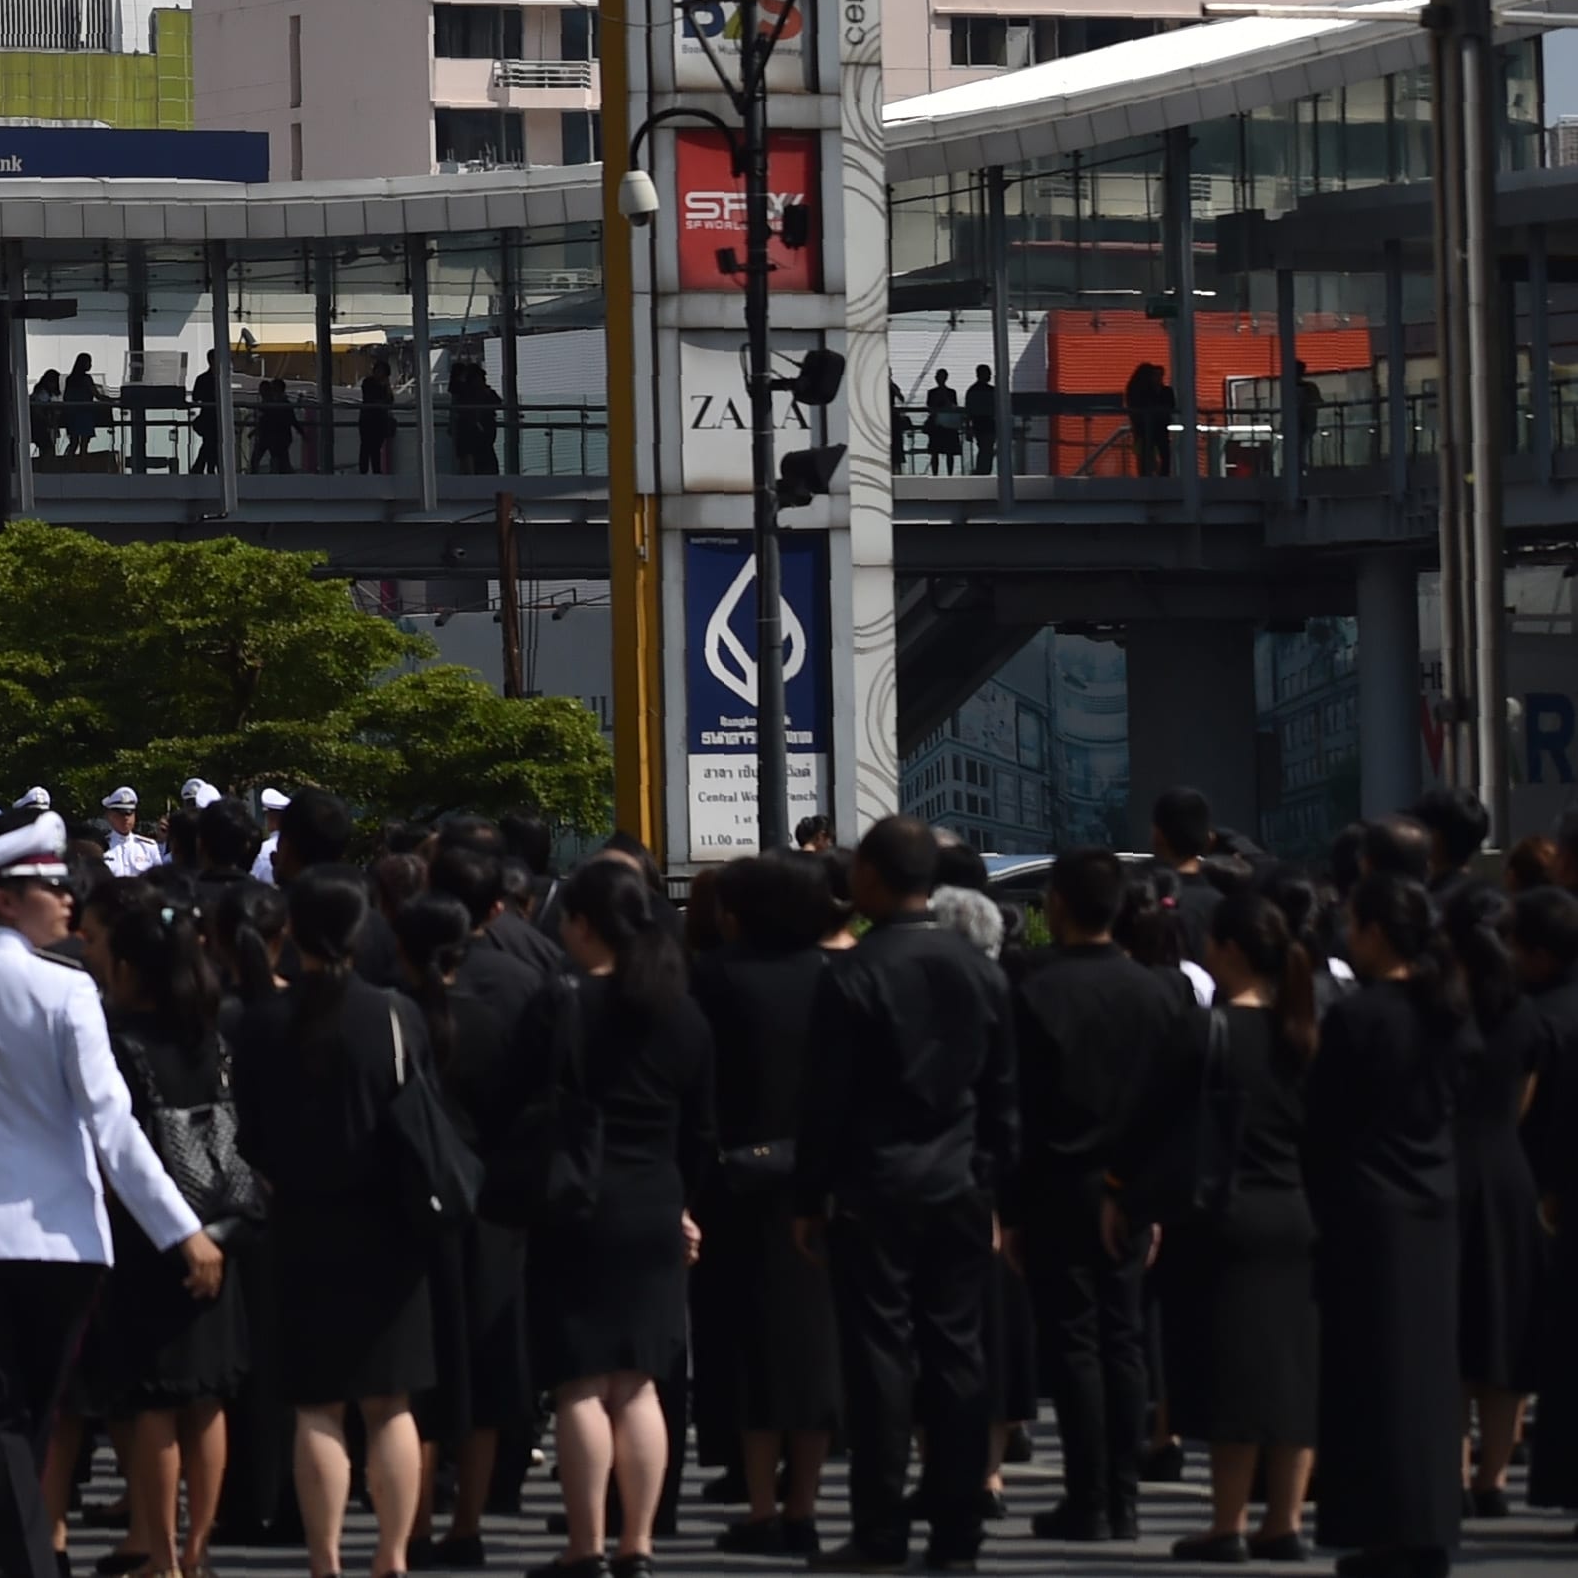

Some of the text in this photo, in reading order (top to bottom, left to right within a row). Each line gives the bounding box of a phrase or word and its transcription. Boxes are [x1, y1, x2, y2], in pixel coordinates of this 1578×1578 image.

[689, 394, 812, 430] ZAA
[698, 792, 738, 803] Central
[700, 834, 733, 846] 11.00
